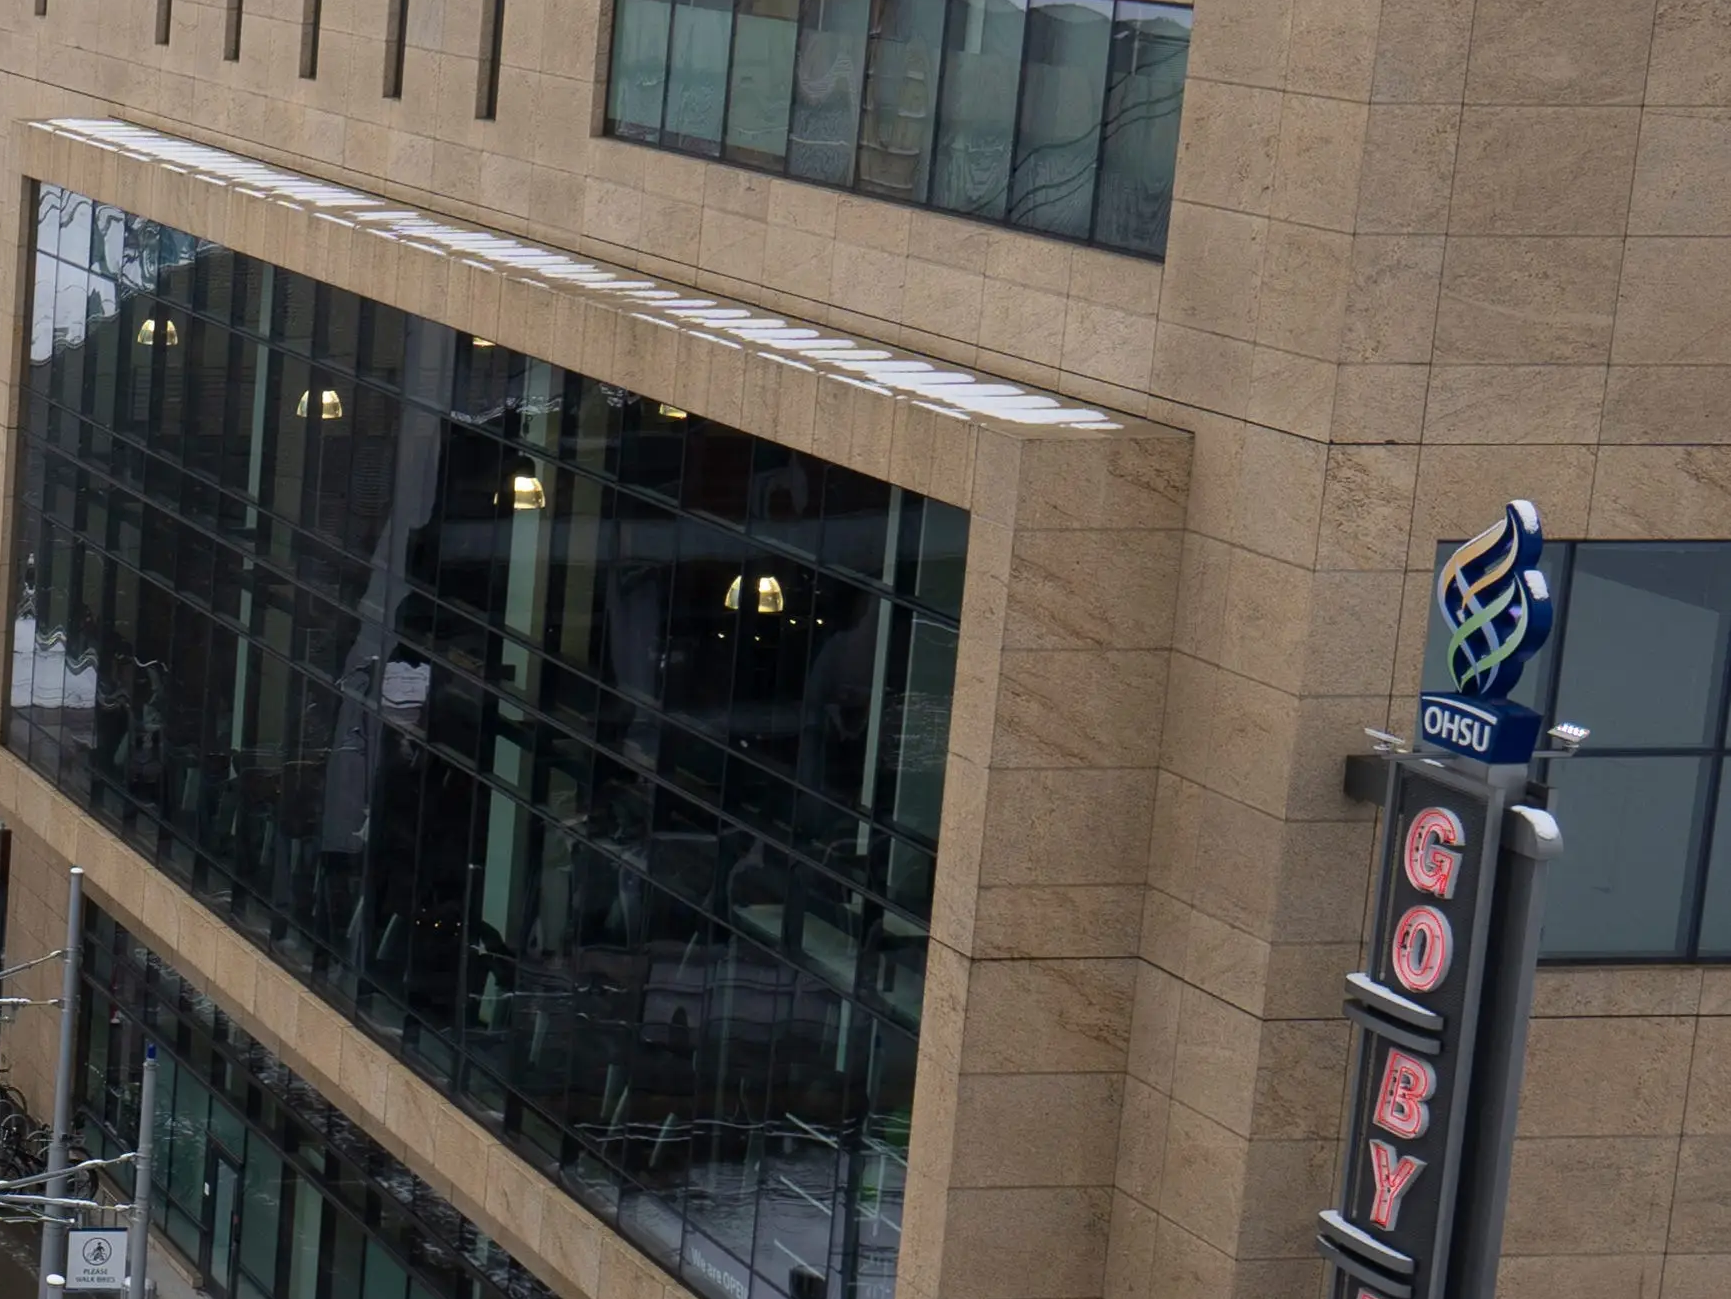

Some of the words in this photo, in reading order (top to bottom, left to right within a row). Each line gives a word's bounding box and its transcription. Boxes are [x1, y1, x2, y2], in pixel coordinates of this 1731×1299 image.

[1424, 705, 1491, 752] OHSU
[1392, 806, 1466, 994] GO
[1369, 1047, 1437, 1231] BY
[690, 1246, 705, 1273] We
[707, 1263, 721, 1284] are
